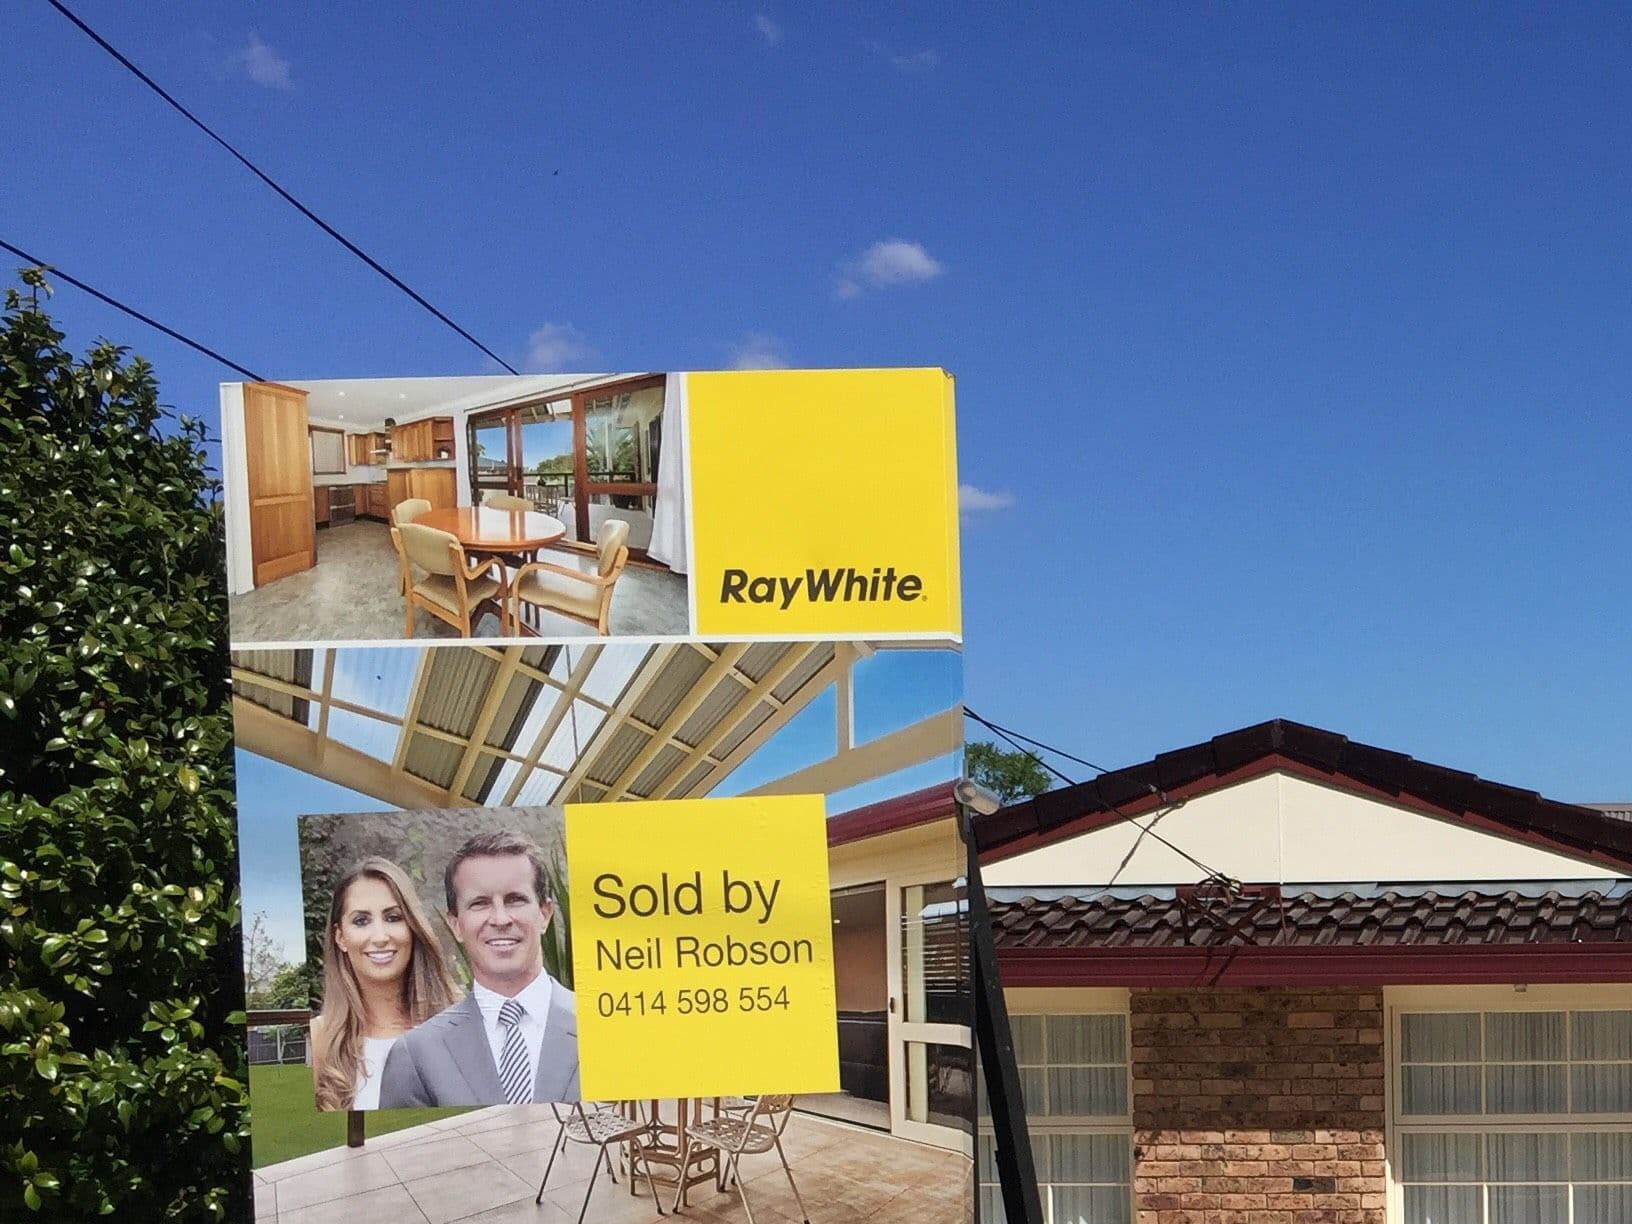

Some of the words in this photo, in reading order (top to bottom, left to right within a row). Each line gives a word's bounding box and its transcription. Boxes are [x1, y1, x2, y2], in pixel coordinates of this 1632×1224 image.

[593, 871, 703, 919] Sold
[723, 870, 781, 924] by
[596, 938, 662, 971] Neil
[677, 935, 813, 968] Robson
[598, 991, 666, 1017] 0414
[677, 989, 729, 1015] 598
[739, 986, 790, 1012] 554
